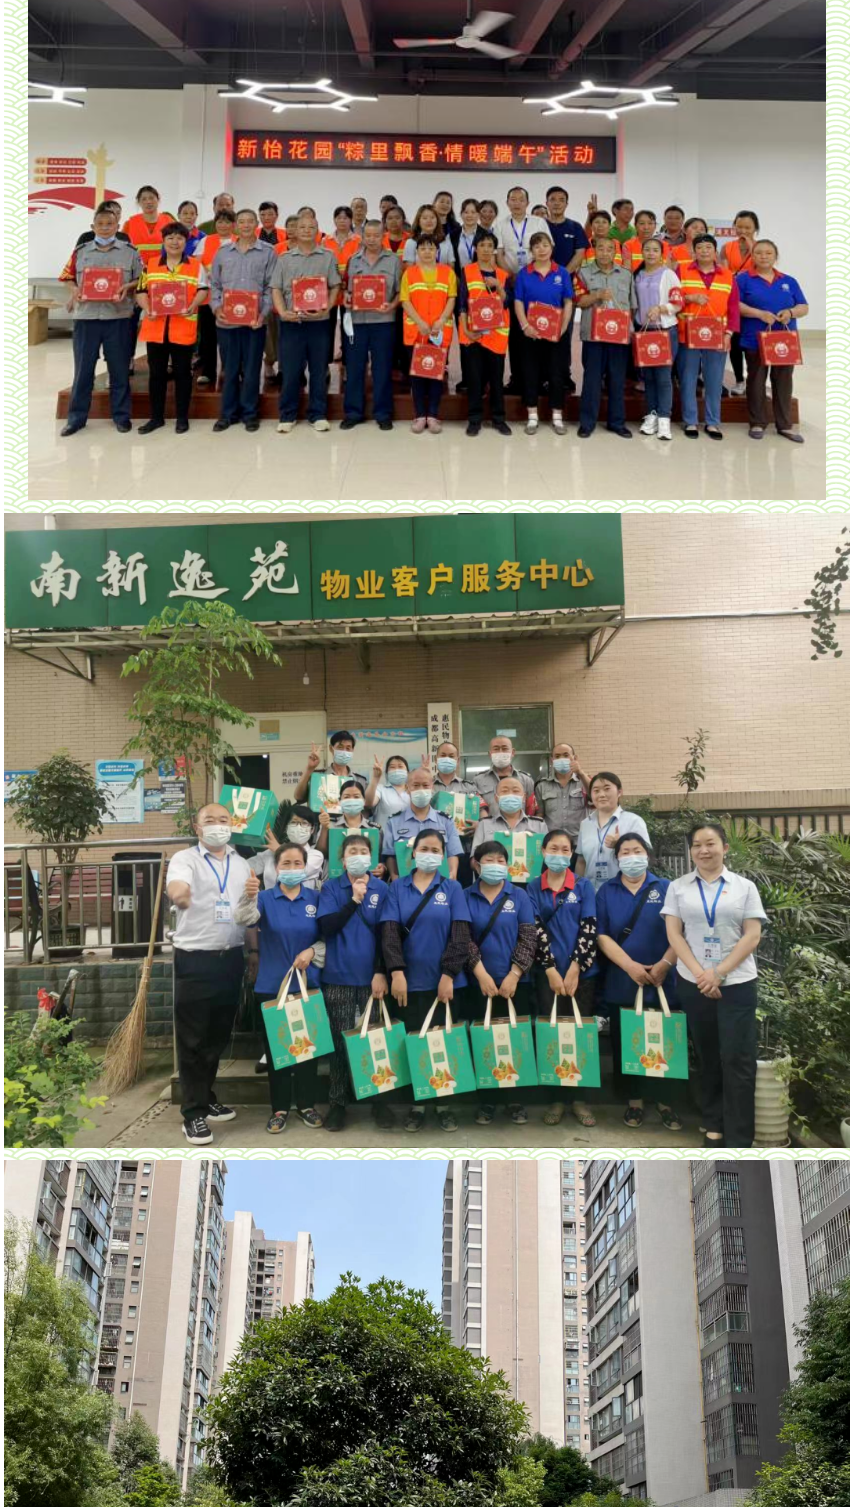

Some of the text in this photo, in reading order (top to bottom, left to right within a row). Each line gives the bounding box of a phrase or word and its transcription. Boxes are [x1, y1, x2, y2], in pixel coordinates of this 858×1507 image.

[30, 540, 595, 607] 南新逸苑 物业客户服务中心
